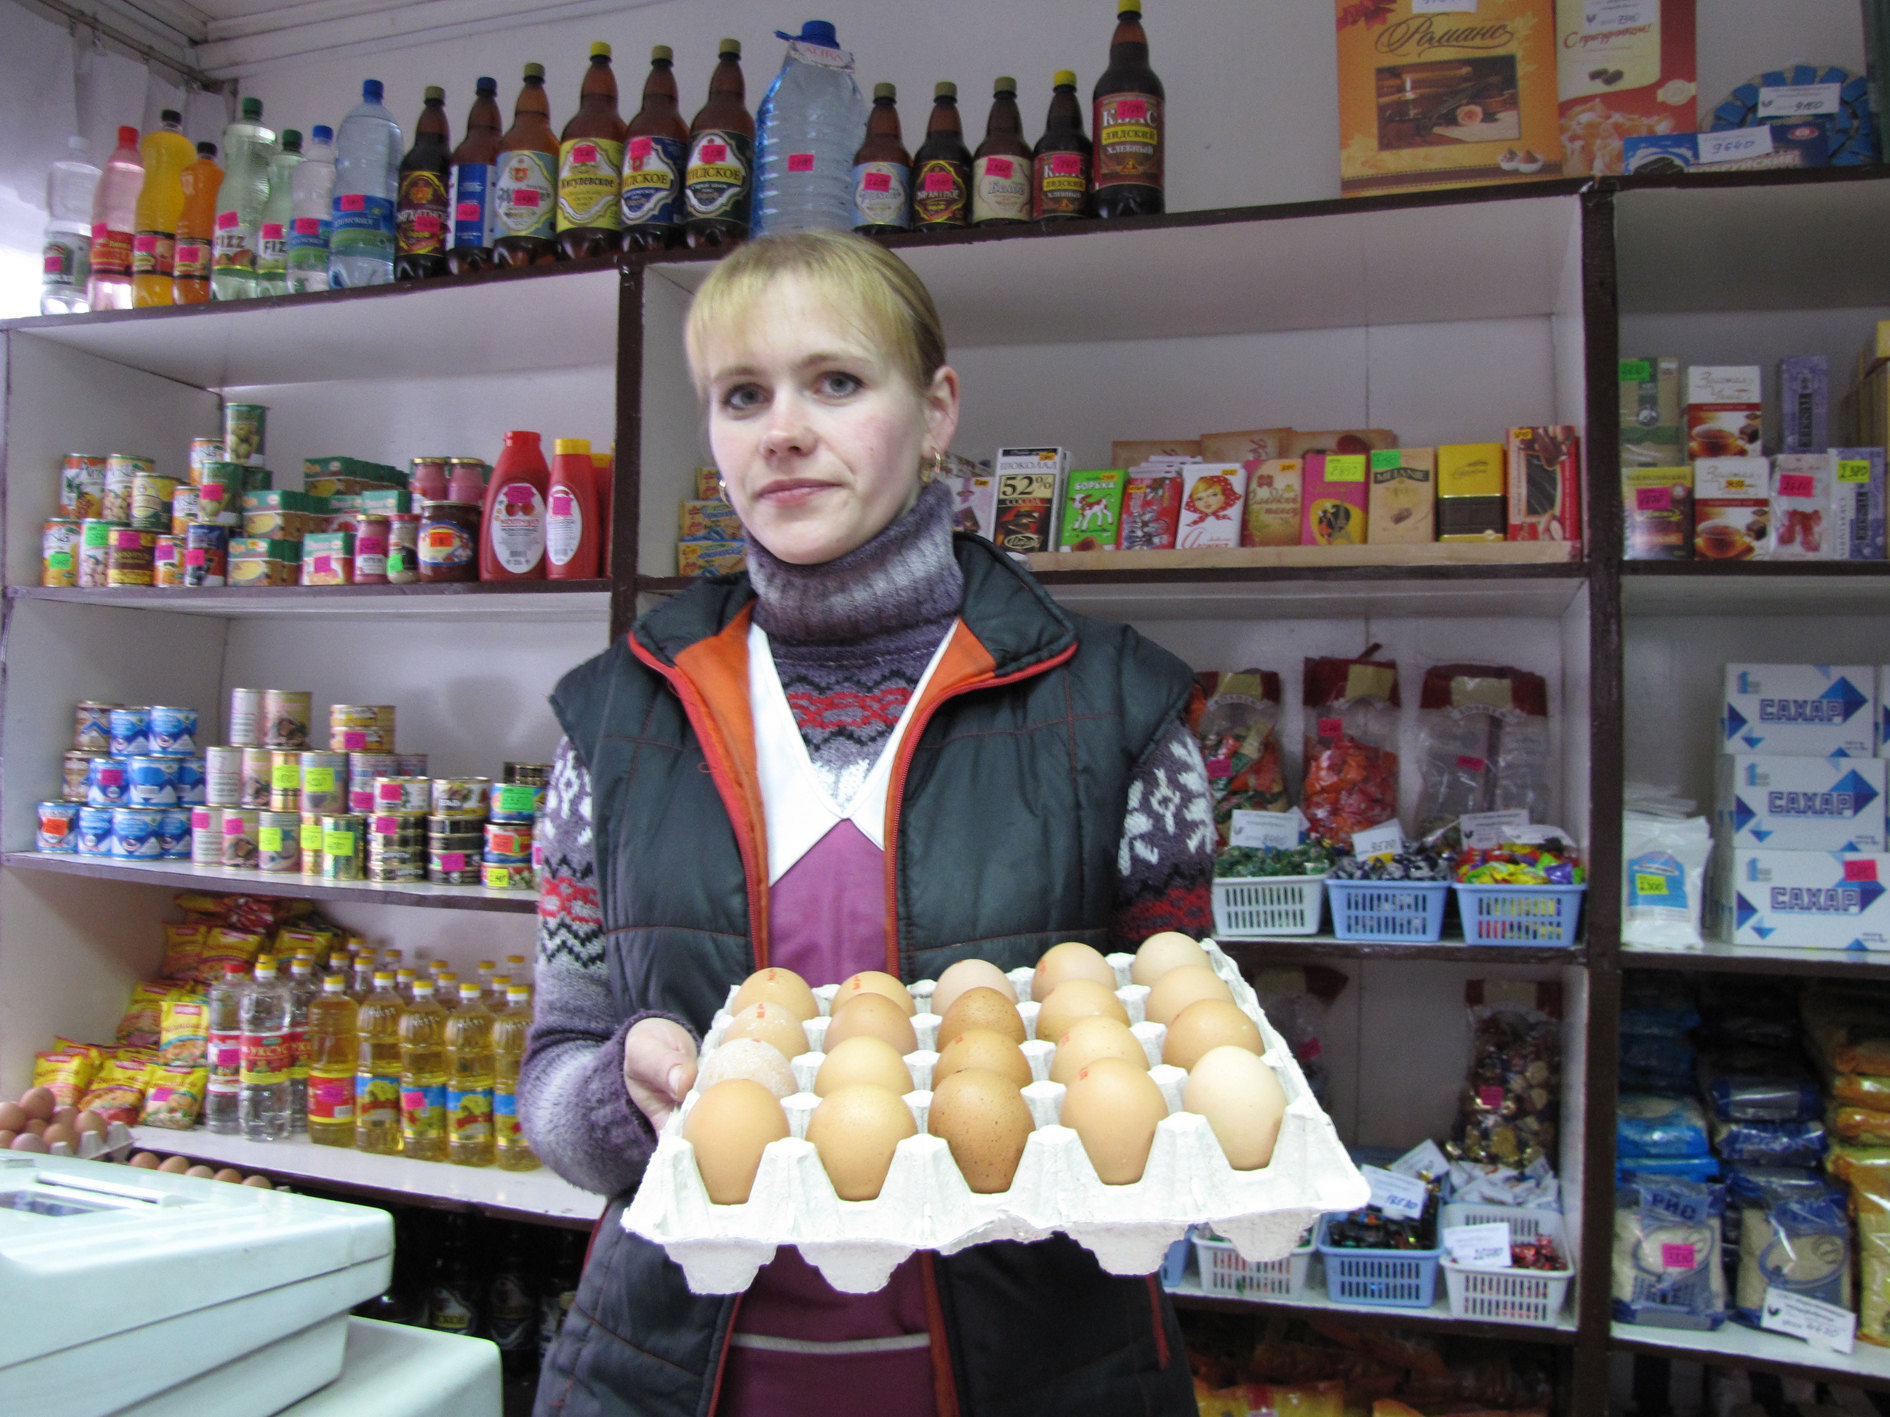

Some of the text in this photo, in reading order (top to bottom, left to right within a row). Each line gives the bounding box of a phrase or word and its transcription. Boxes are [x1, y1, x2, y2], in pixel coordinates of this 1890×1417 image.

[1001, 475, 1053, 498] 52%
[1759, 698, 1844, 723] САХАР
[1768, 791, 1852, 816] САХАР
[1770, 886, 1861, 912] САХАР
